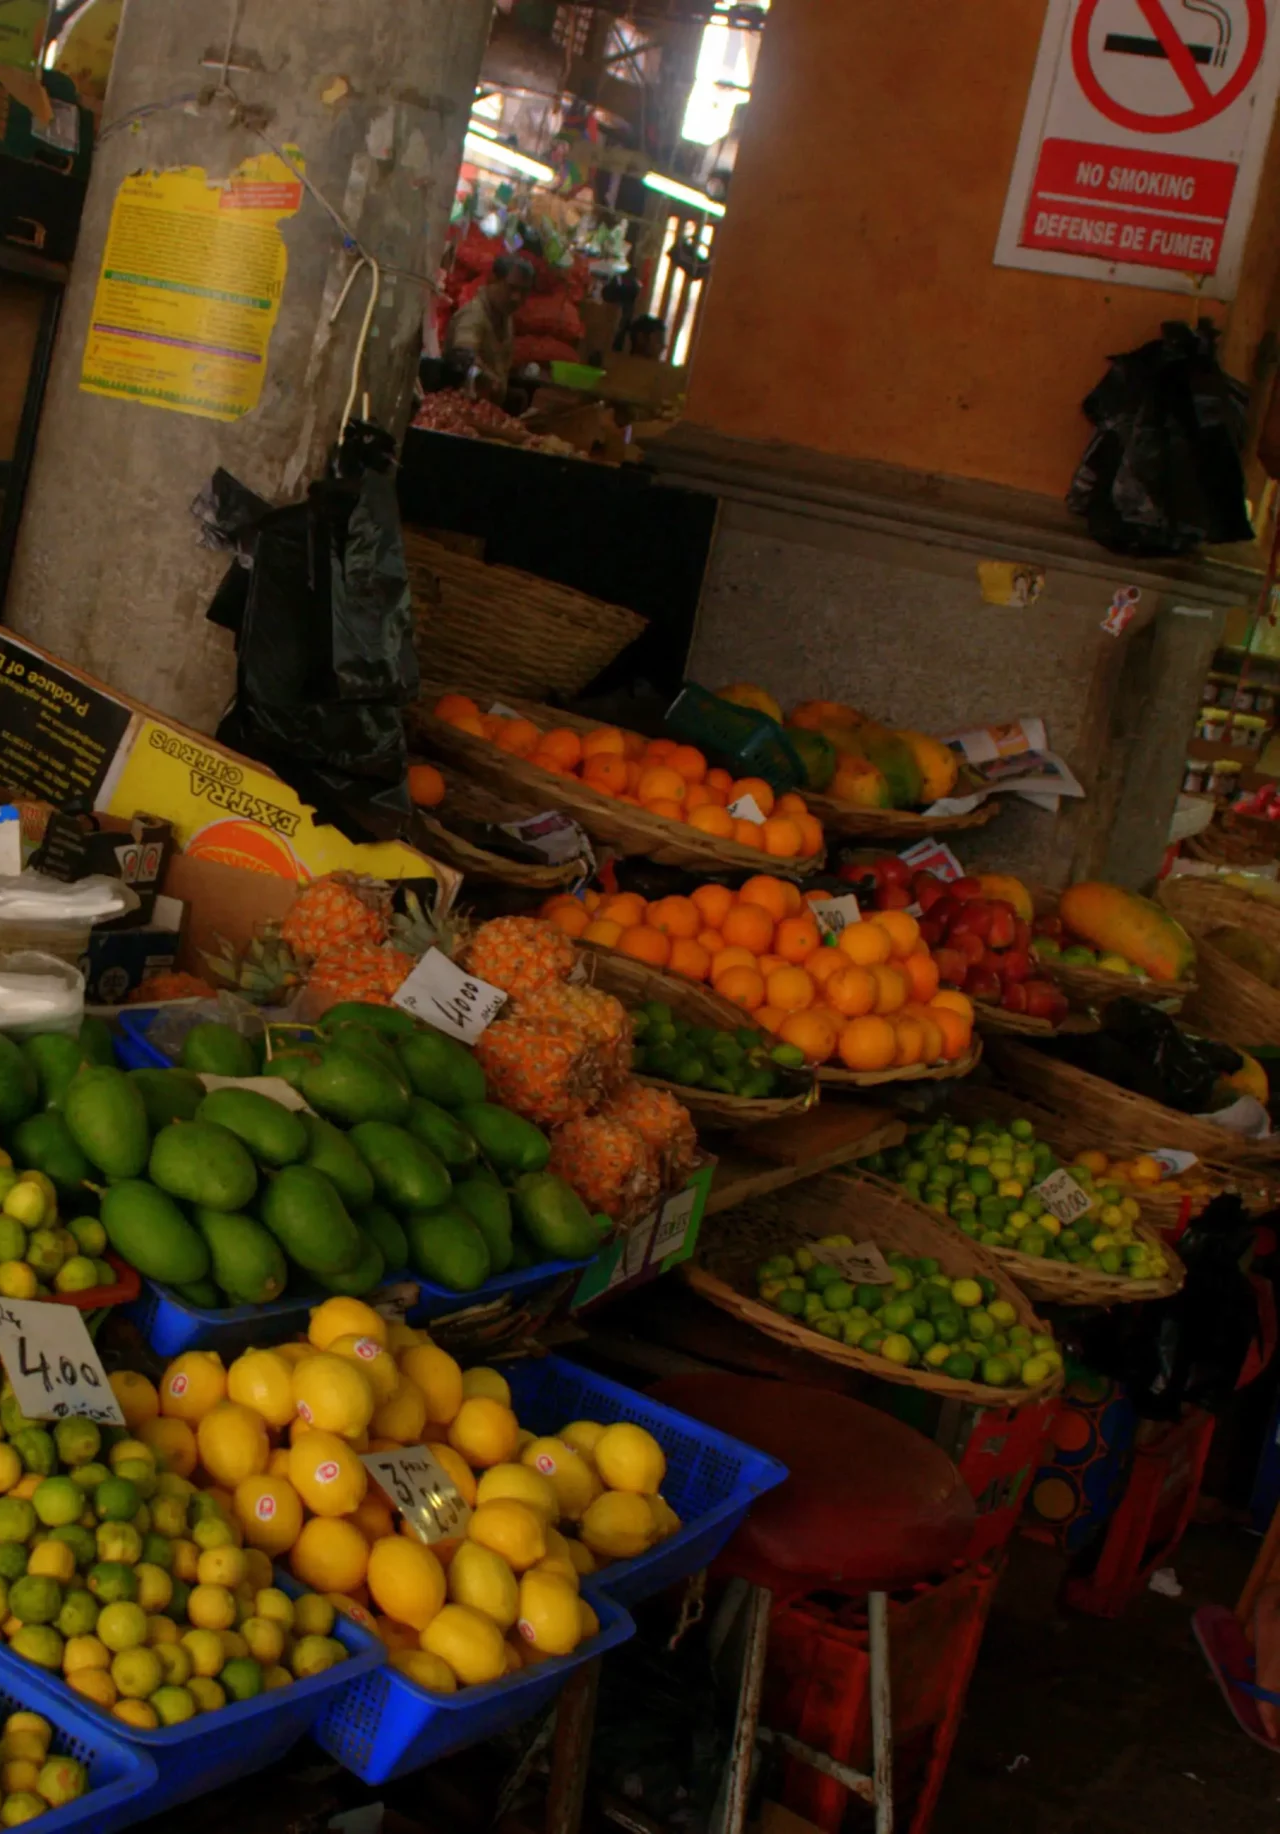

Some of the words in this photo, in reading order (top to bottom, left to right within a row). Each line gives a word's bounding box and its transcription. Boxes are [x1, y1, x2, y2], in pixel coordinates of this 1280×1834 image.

[1076, 161, 1104, 187] NO
[1107, 166, 1195, 200] SMOKING
[1034, 212, 1118, 245] DEFENSE
[1119, 224, 1146, 250] DE
[1149, 229, 1214, 261] FUMER
[5, 659, 27, 682] of
[26, 669, 92, 718] Produce
[149, 728, 244, 787] CITRUS
[191, 770, 300, 837] EXTRA
[18, 1336, 101, 1392] 4.00
[378, 1463, 415, 1507] 3
